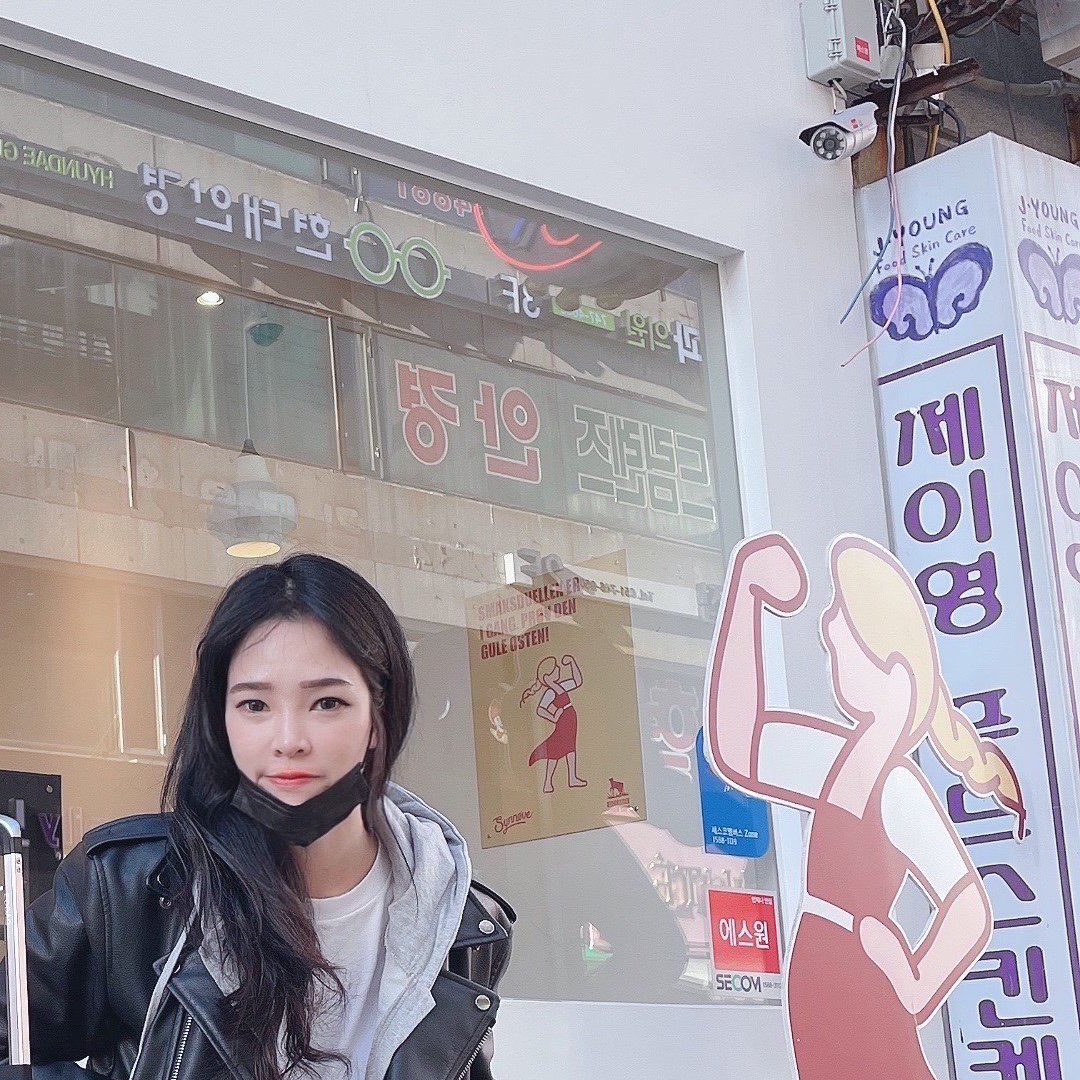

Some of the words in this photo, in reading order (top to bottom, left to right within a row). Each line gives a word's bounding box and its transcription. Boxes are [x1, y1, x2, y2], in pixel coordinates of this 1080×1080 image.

[912, 241, 940, 258] Skin
[945, 225, 977, 243] Care
[894, 385, 1003, 636] 제이영
[481, 640, 508, 660] GULE
[509, 626, 550, 652] OSTEN!
[719, 918, 770, 949] 에스원
[716, 974, 761, 992] SECOM
